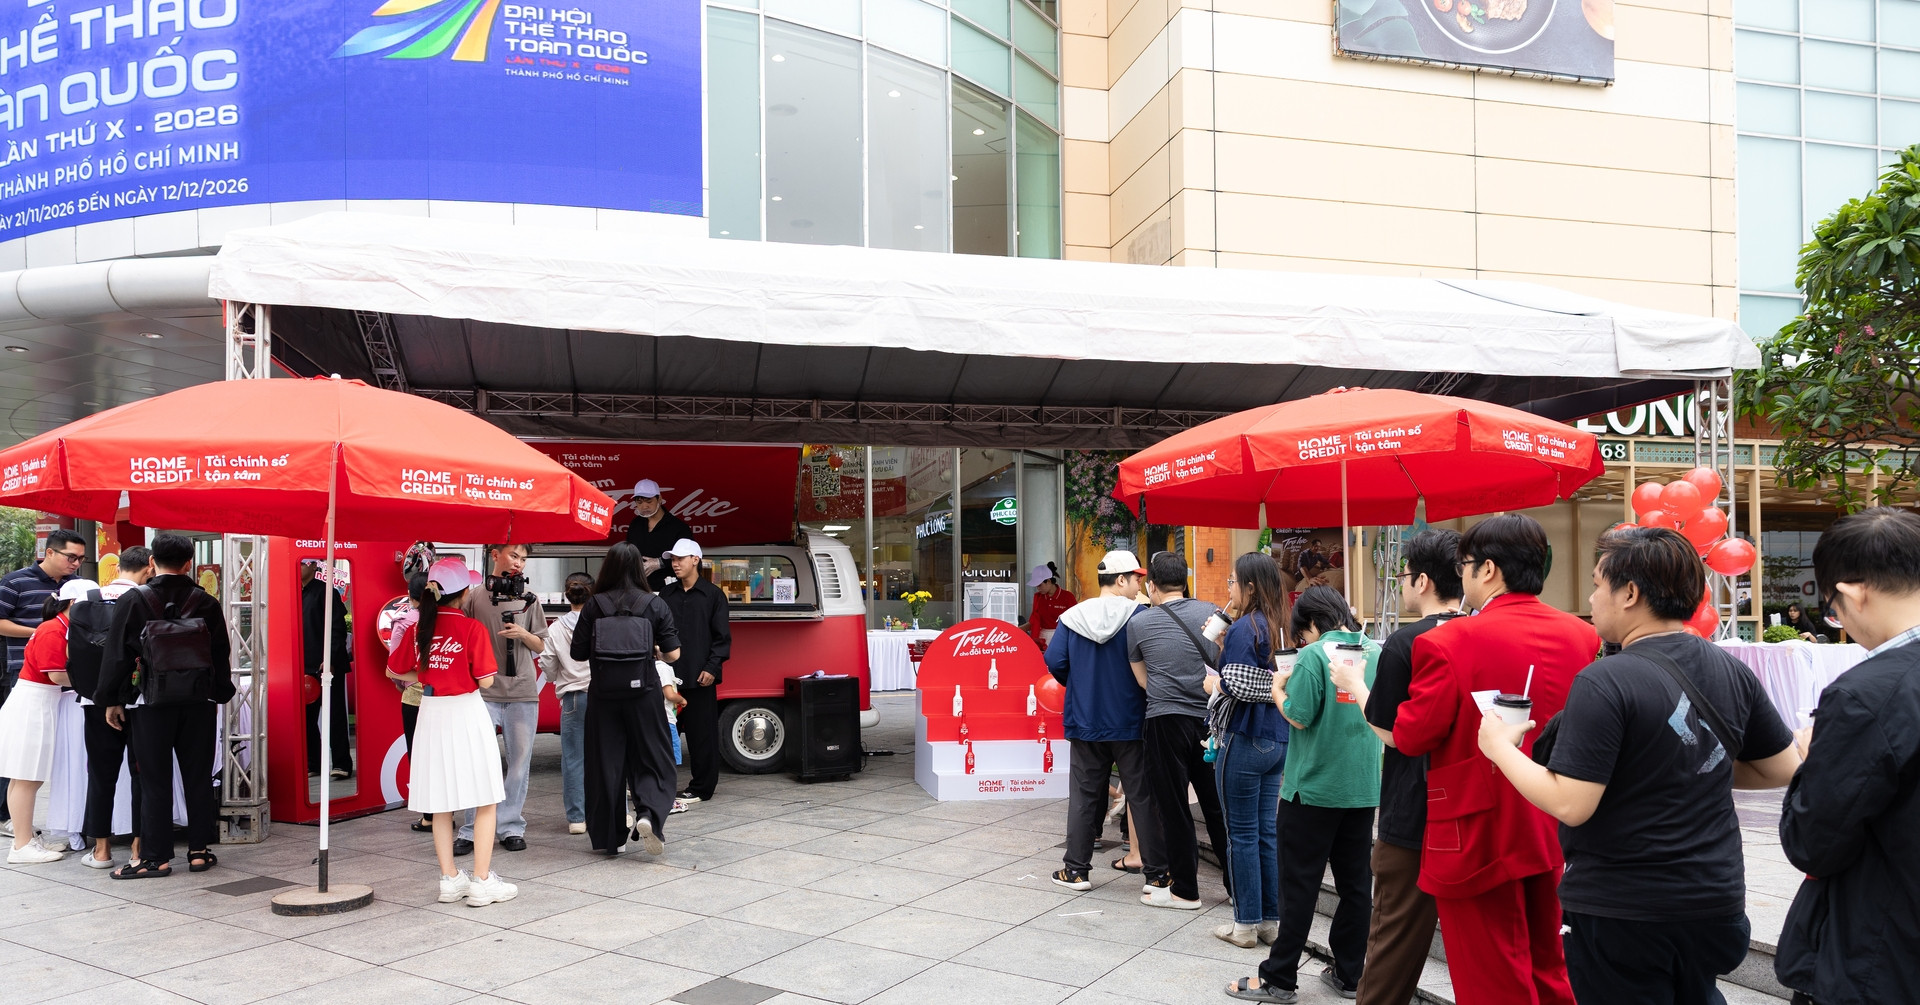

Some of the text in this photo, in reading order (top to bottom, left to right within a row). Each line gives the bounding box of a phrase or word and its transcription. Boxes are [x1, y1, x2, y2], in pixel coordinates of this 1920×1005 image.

[504, 4, 592, 26] ĐẠI HỘI
[70, 0, 238, 50] THAO
[561, 25, 628, 45] THAO
[577, 43, 648, 65] QUỐC
[59, 36, 238, 115] QUỐC
[603, 76, 630, 86] MINH
[0, 139, 38, 168] ẦN
[46, 120, 97, 153] THỨ
[106, 119, 125, 140] X
[155, 104, 239, 133] 2026
[55, 155, 93, 185] PHỐ
[99, 149, 128, 177] HỒ
[134, 144, 171, 171] CHÍ
[179, 142, 239, 165] MINH
[15, 200, 74, 227] 21/11/2026
[78, 191, 110, 214] ĐẾN
[114, 185, 158, 208] NGÀY
[162, 177, 249, 201] 12/12/2026
[1355, 424, 1422, 440] Tài chính số
[1502, 430, 1530, 442] HOME
[1298, 435, 1341, 450] HOME
[1355, 440, 1401, 453] tận tâm
[1504, 440, 1533, 453] CREDIT
[563, 453, 621, 461] Tài chính số
[1176, 449, 1217, 467] Tài chính số
[1299, 444, 1347, 460] CREDIT
[130, 456, 187, 470] HOME
[205, 453, 290, 467] Tài chính số
[563, 460, 603, 469] tận tâm
[130, 468, 194, 483] CREDIT
[205, 469, 261, 482] tận tâm
[401, 468, 452, 484] HOME
[1144, 462, 1168, 477] HOME
[1176, 466, 1204, 479] tận tâm
[466, 473, 535, 490] Tài chính số
[1145, 471, 1171, 486] CREDIT
[401, 481, 457, 496] CREDIT
[465, 487, 513, 501] tận tâm
[930, 515, 946, 534] LONG
[296, 540, 358, 550] CREDIT ận tâm
[334, 577, 346, 588] ực
[949, 626, 1012, 657] Trợ lực
[442, 656, 454, 664] tay
